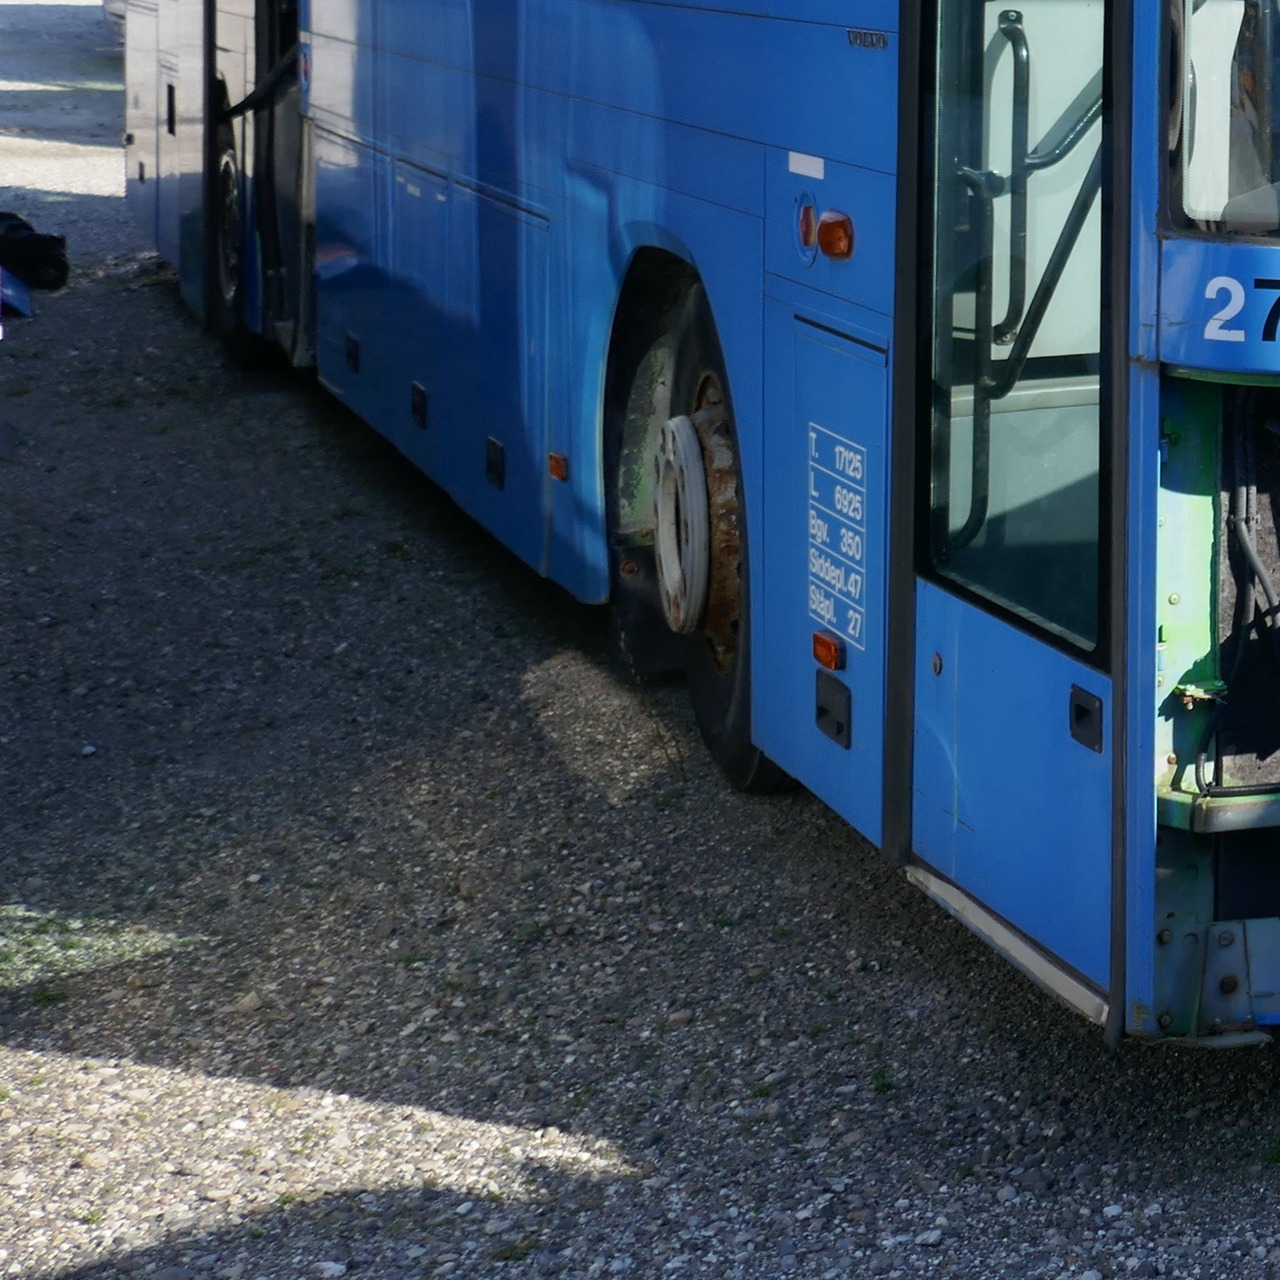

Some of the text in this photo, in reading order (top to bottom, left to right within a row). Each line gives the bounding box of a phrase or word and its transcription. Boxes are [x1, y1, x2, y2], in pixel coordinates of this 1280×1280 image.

[846, 29, 888, 49] VOLVO
[834, 445, 863, 480] 17125
[834, 485, 863, 521] 6925
[840, 528, 862, 560] 350
[809, 548, 862, 599] Siddepl. 47
[847, 609, 862, 638] 27
